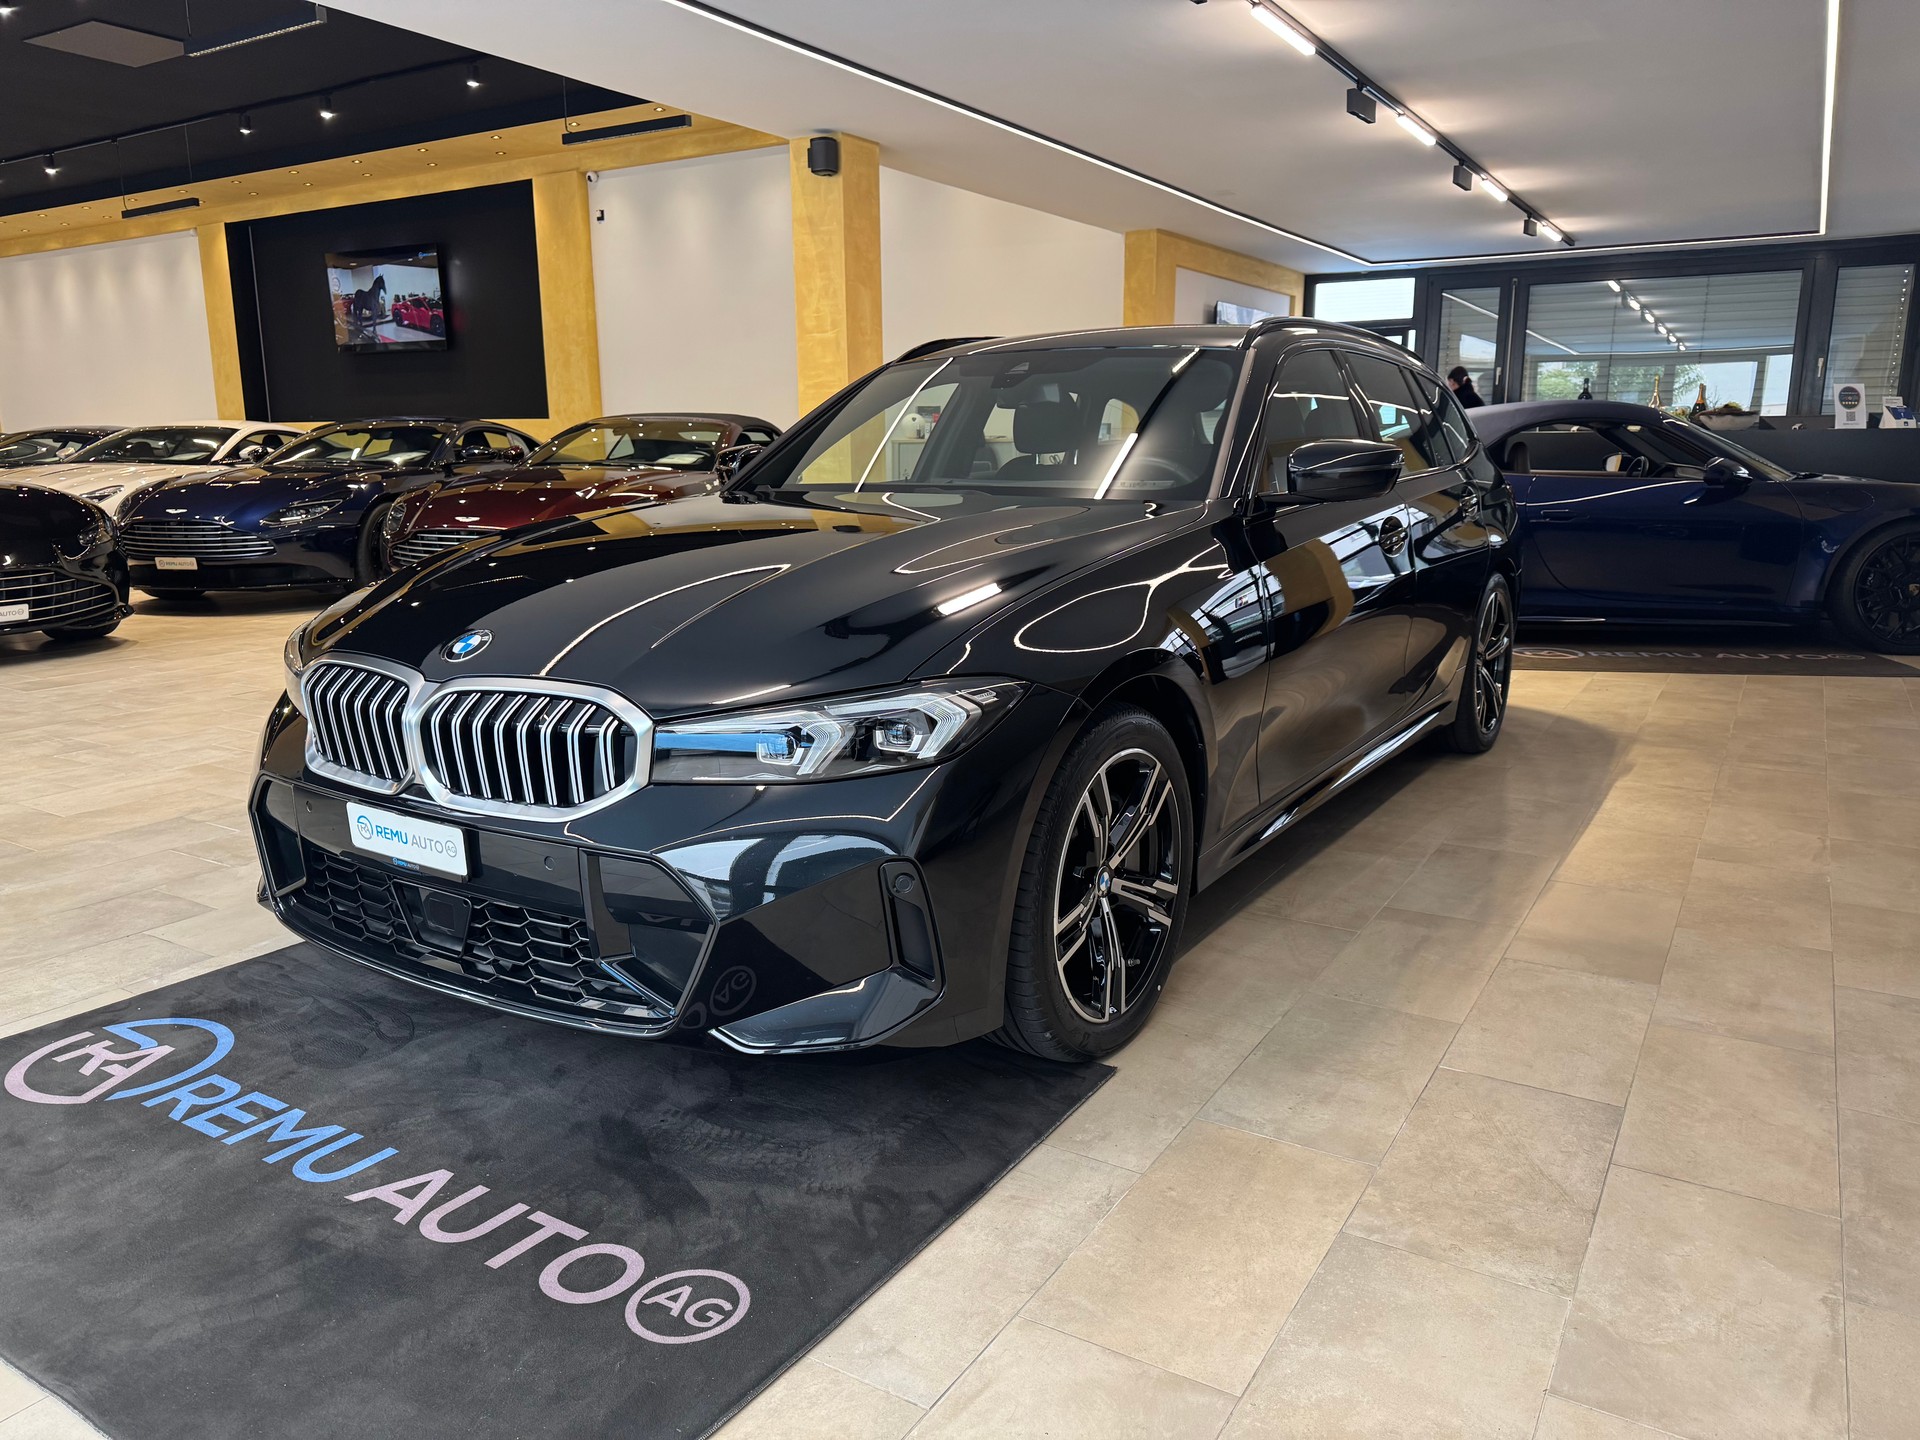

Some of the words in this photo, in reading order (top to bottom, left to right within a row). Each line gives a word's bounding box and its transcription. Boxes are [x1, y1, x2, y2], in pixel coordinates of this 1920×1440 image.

[375, 825, 408, 845] REMU
[411, 834, 443, 854] AUTO
[141, 1074, 399, 1182] REMU
[344, 1169, 645, 1304] AUTO
[641, 1285, 733, 1328] AG
